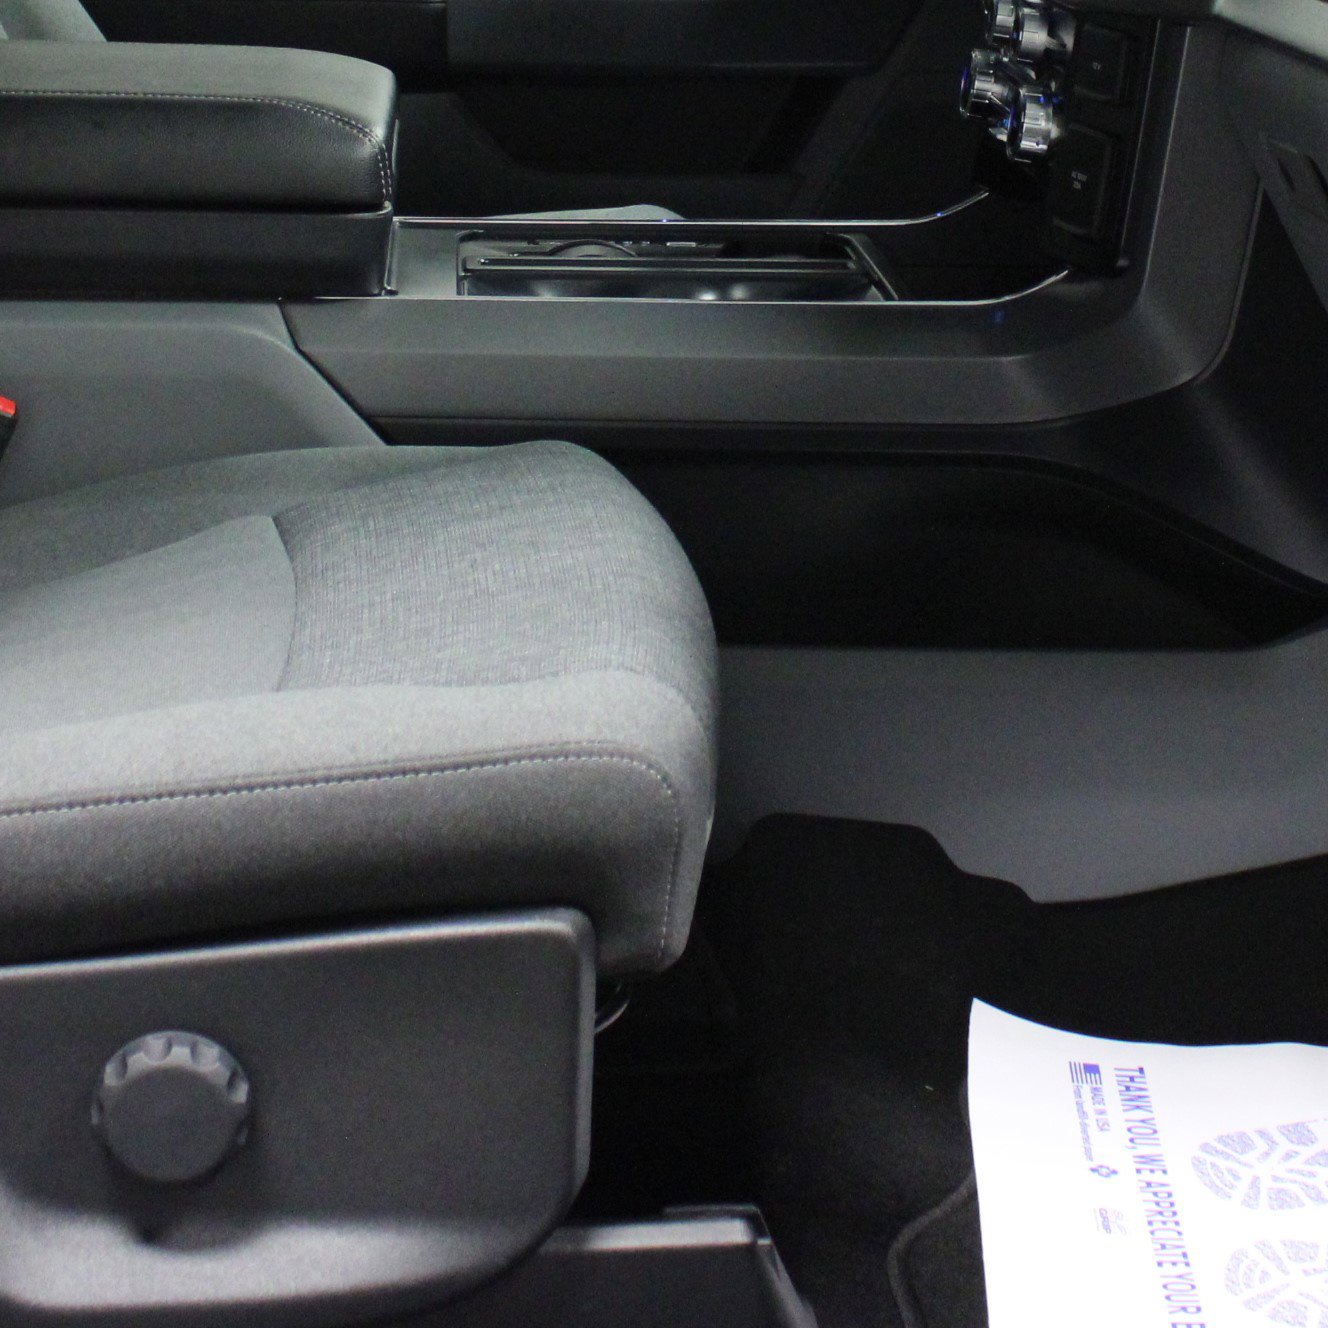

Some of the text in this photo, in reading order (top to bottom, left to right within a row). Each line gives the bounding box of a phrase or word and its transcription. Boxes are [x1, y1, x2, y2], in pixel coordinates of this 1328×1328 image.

[1113, 1067, 1154, 1114] THANK
[1124, 1117, 1161, 1150] YOU,
[1132, 1154, 1168, 1175] WE
[1138, 1179, 1191, 1268] APPRECIATE
[1160, 1272, 1202, 1315] YOUR
